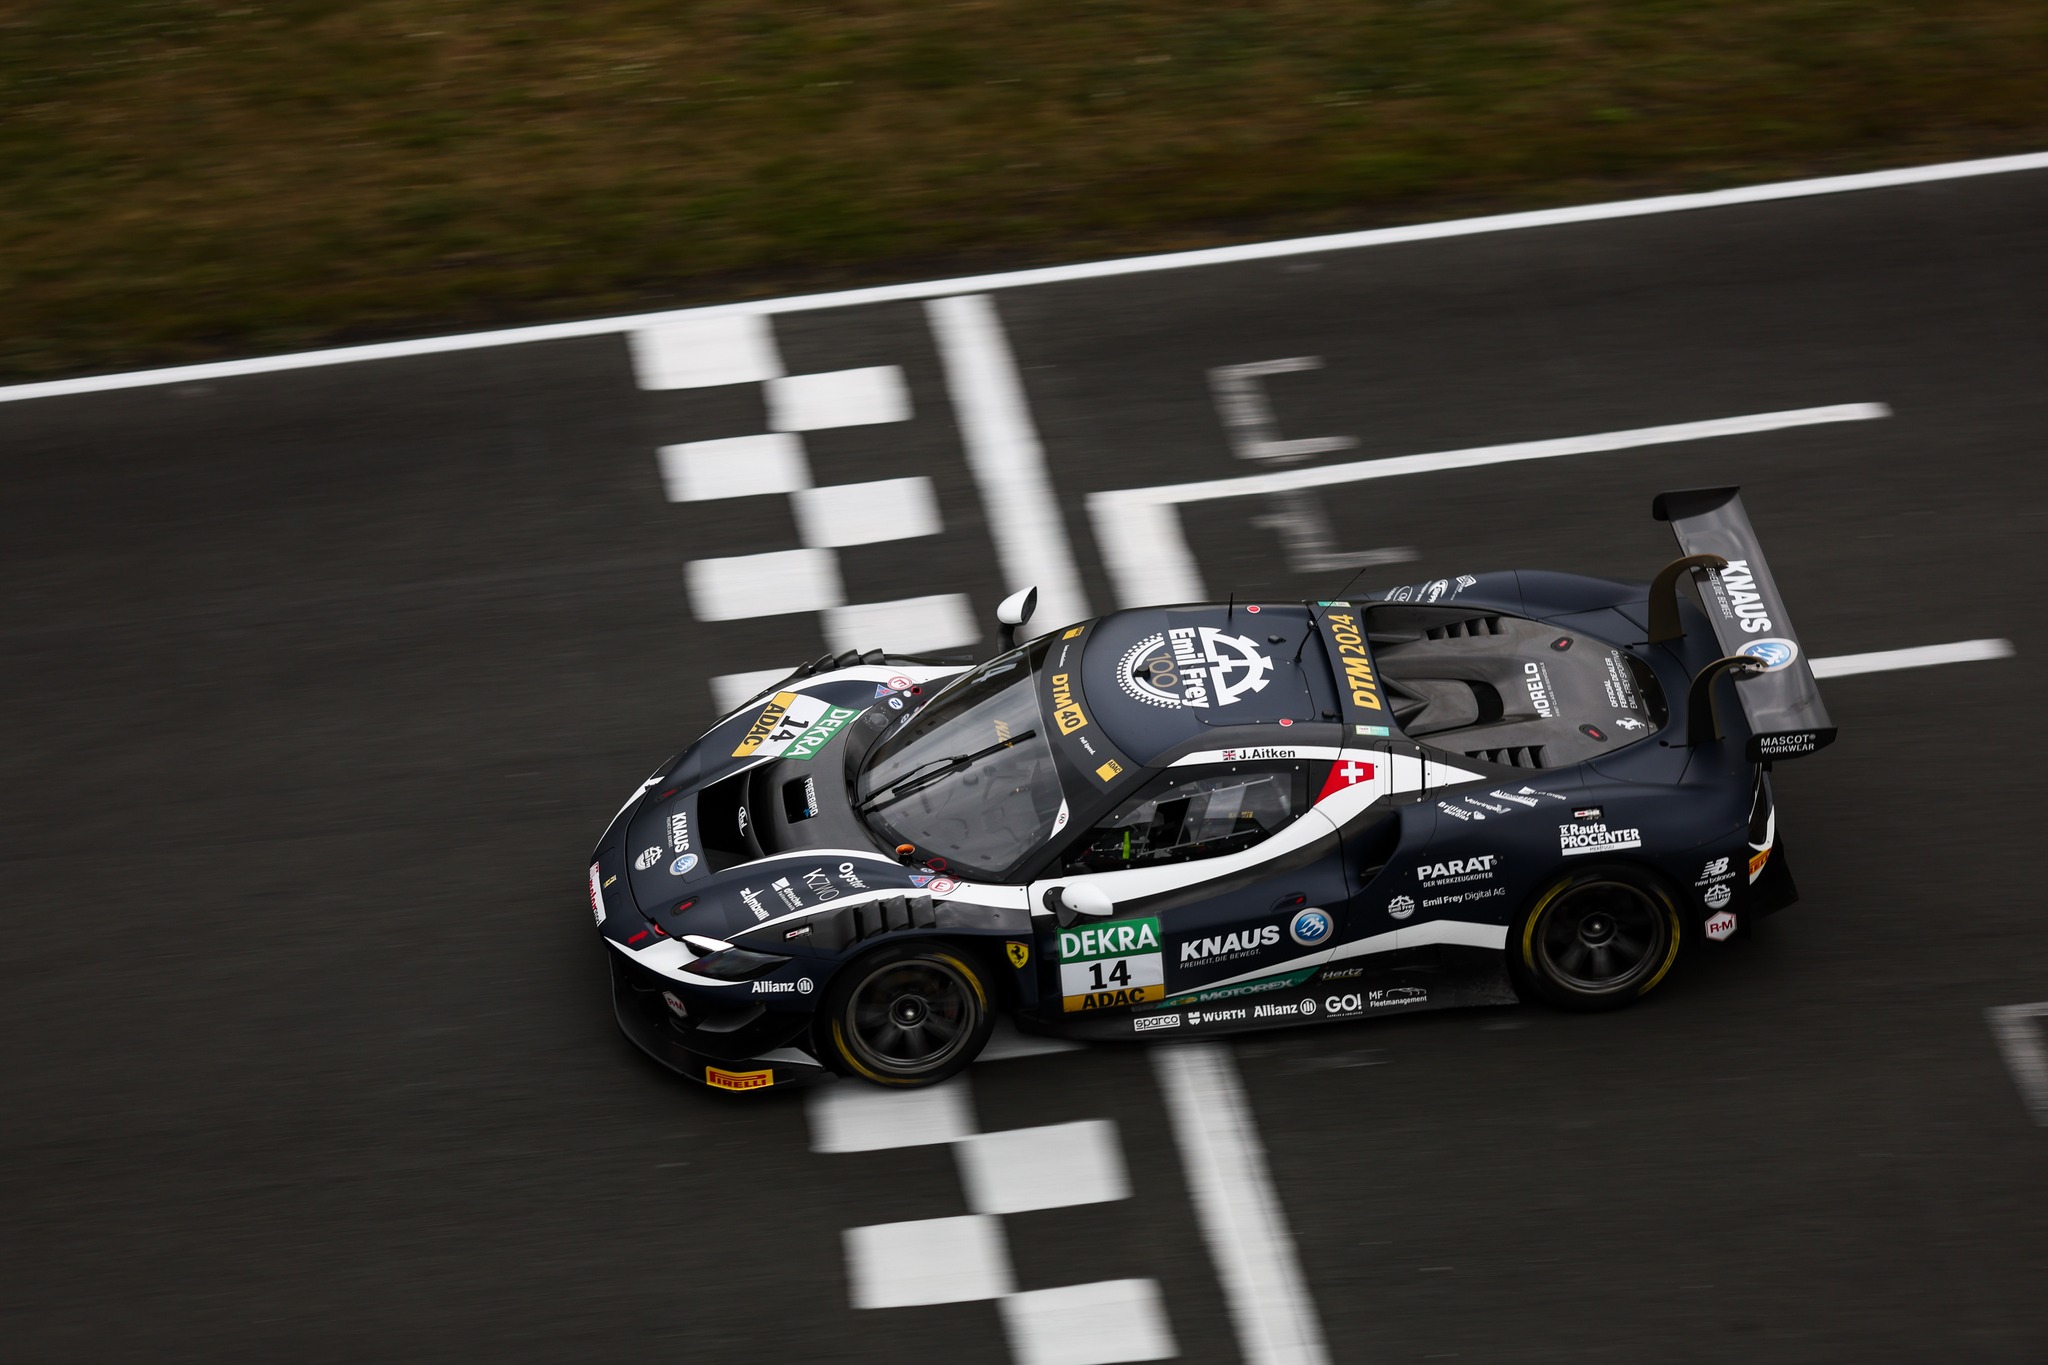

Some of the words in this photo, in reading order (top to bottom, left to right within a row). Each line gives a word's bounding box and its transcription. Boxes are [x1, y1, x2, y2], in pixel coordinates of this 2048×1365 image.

[1720, 560, 1772, 633] KNAUS
[1168, 627, 1207, 667] Emil
[1327, 614, 1366, 656] 2024
[1146, 652, 1178, 688] 100
[1604, 657, 1619, 683] DEALER
[1052, 673, 1073, 710] DTM
[1179, 667, 1210, 708] Frey
[1342, 657, 1381, 711] DTM
[1524, 662, 1553, 718] MORELO
[1604, 680, 1618, 708] OFFICIAL
[1613, 681, 1628, 709] FERRARI
[743, 703, 785, 746] ADAC
[769, 715, 809, 742] 14
[1061, 710, 1081, 729] 40
[785, 708, 854, 757] DEKRA
[1239, 749, 1296, 760] J.Aitken
[1761, 743, 1815, 754] WORKWEAR
[672, 812, 689, 853] KNAUS
[1560, 828, 1641, 849] PROCENTER
[1423, 879, 1436, 888] DER
[1437, 871, 1494, 886] WERKZEUGKOFFER
[1694, 879, 1709, 887] new
[1709, 871, 1736, 884] balance
[1423, 897, 1443, 907] Emil
[1443, 894, 1463, 905] Frey
[1464, 889, 1492, 901] Digital
[1493, 886, 1506, 897] AG
[1060, 923, 1158, 959] DEKRA
[1180, 925, 1281, 962] KNAUS
[1088, 959, 1132, 991] 14
[1322, 968, 1364, 981] Hertz
[752, 981, 795, 993] Allianz
[1082, 987, 1146, 1010] ADAC
[1200, 979, 1293, 1002] MOTOREX
[1369, 990, 1383, 1000] MF
[1254, 1004, 1298, 1018] Allianz
[1325, 993, 1362, 1013] GO!
[1370, 996, 1427, 1007] Fleetmanagement
[1136, 1016, 1179, 1030] sparco
[1202, 1009, 1246, 1022] WÜRTH
[710, 1071, 767, 1088] PIRELLI
